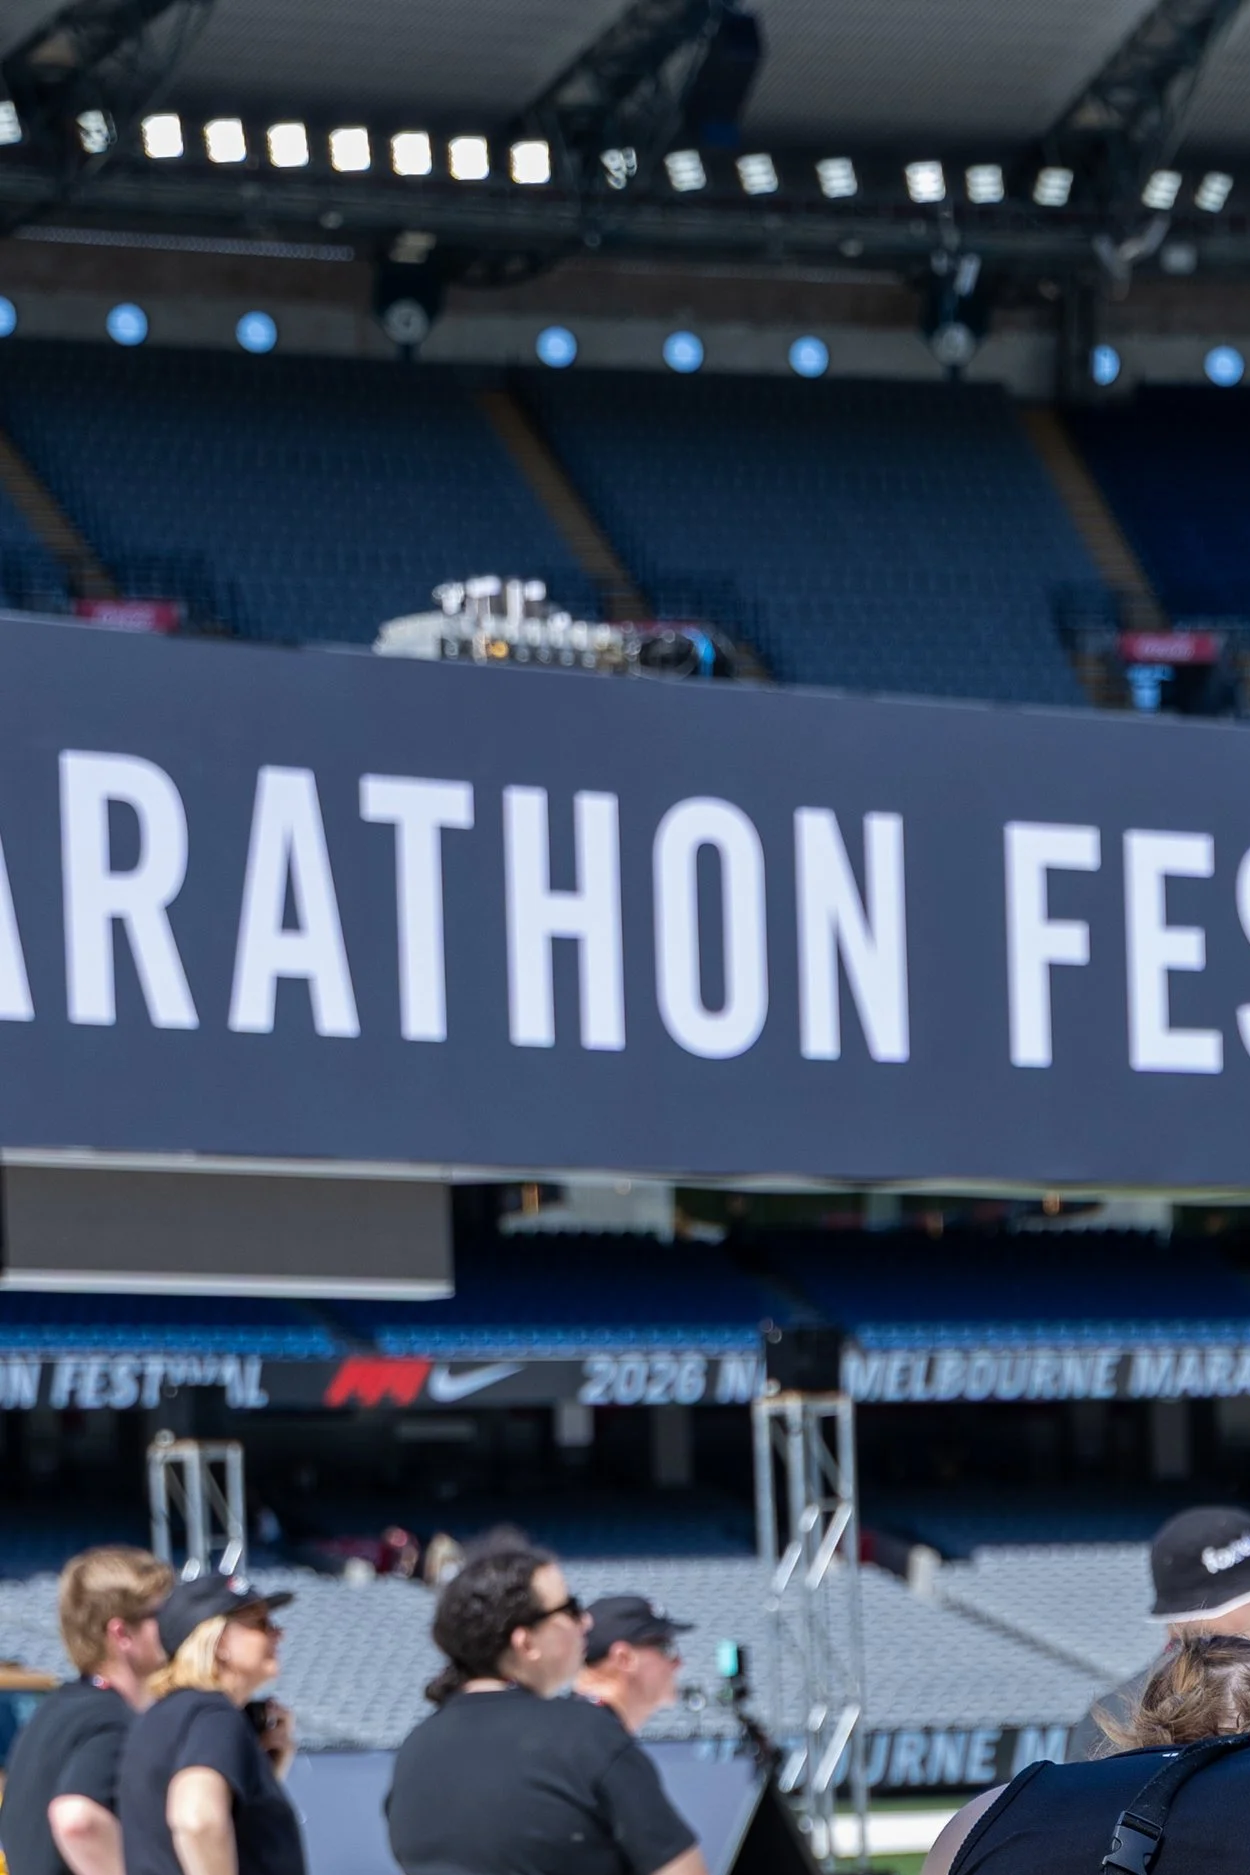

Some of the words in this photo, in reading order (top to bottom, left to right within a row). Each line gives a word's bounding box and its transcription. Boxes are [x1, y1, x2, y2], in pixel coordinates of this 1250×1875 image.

[0, 748, 912, 1064] RATHON
[578, 1351, 708, 1405] 2026
[840, 1347, 1120, 1403] MELBOURNE
